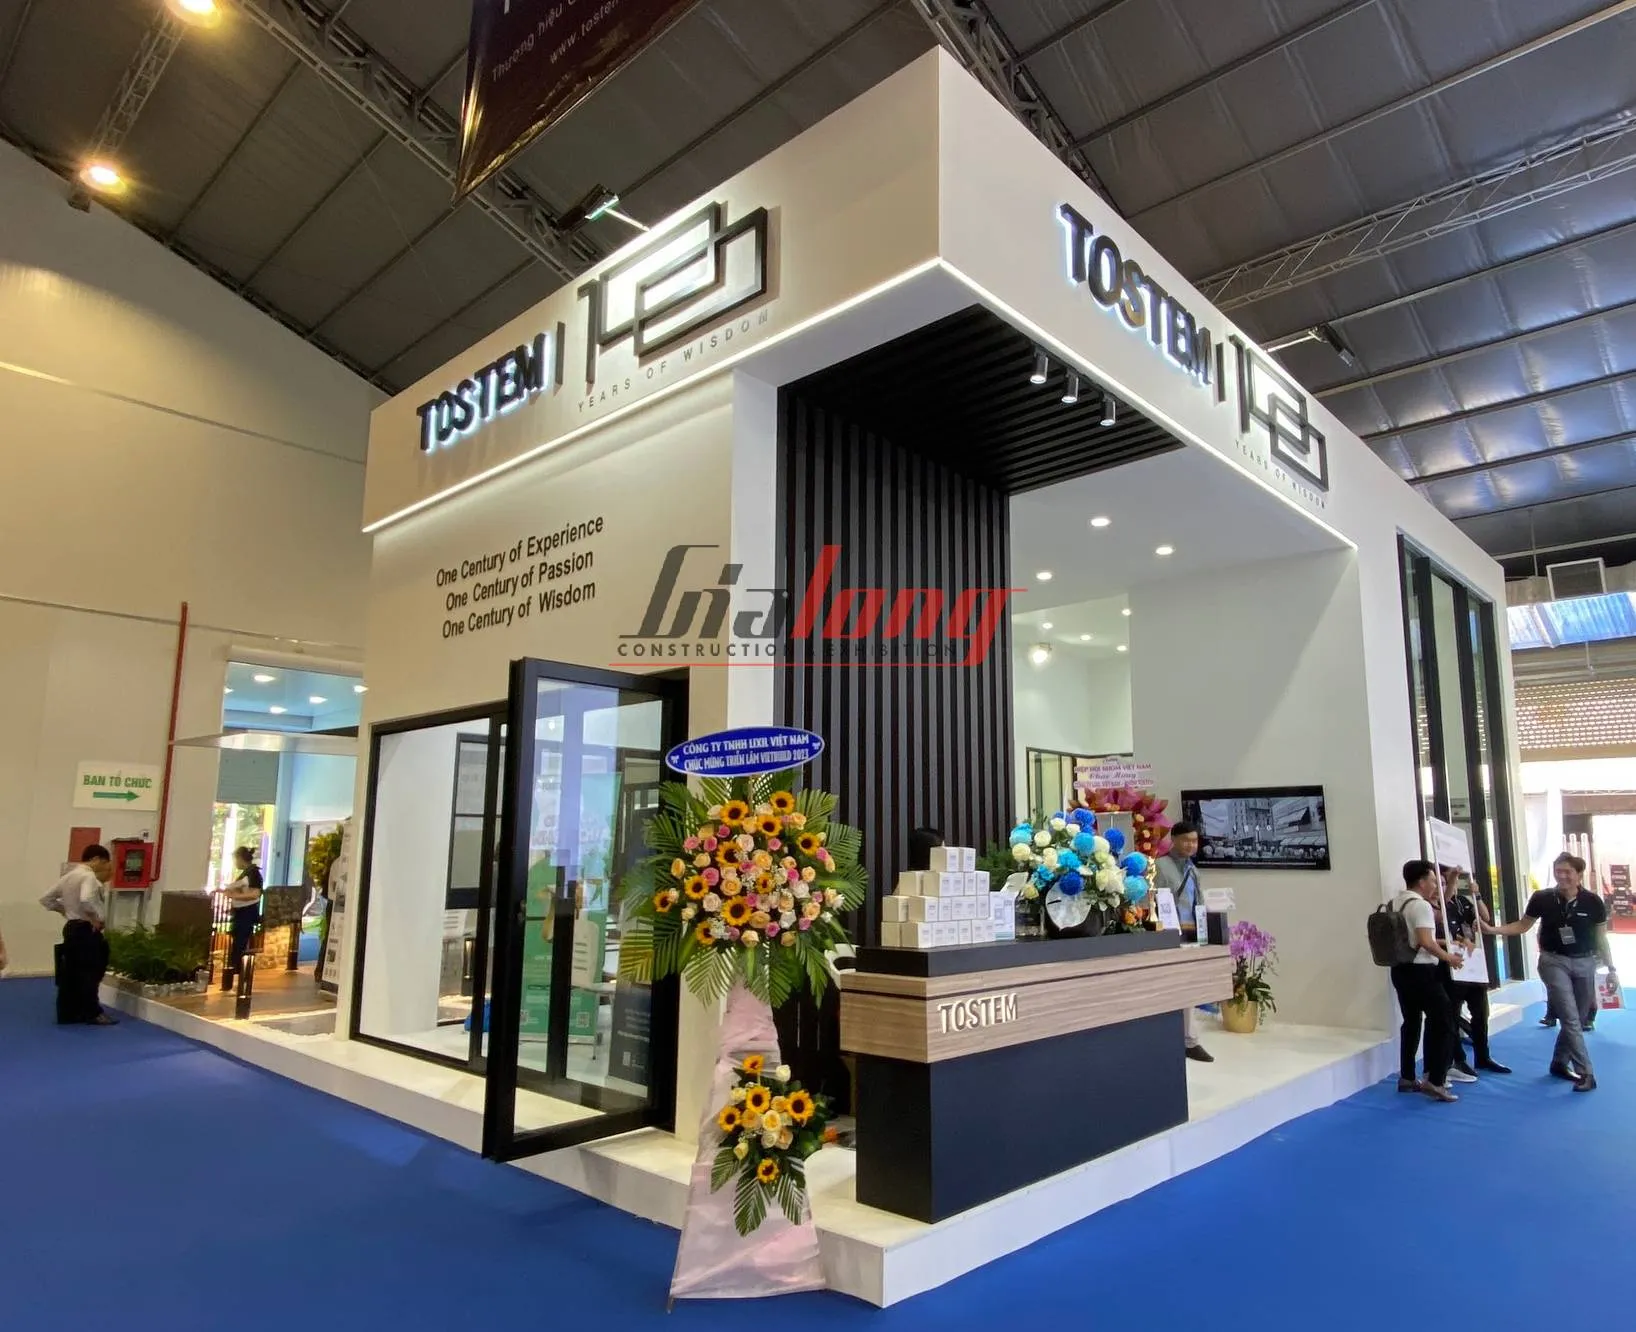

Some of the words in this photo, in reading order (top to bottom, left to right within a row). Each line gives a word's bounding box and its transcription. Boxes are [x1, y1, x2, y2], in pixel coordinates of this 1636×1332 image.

[1056, 203, 1212, 386] TOSTEM
[578, 378, 631, 412] YEARS
[646, 361, 668, 379] OF
[683, 309, 768, 361] WISDOM
[416, 332, 548, 452] TOSTEM
[436, 567, 457, 587] One
[461, 551, 505, 579] Century
[509, 540, 523, 562] of
[527, 516, 603, 556] Experience
[442, 620, 464, 638] One
[468, 605, 515, 632] Century
[518, 596, 532, 618] of
[538, 582, 596, 613] Wisdom
[446, 591, 468, 611] One
[473, 575, 519, 602] Century
[521, 565, 535, 588] of
[538, 551, 593, 584] Passion
[683, 741, 709, 755] CÔNG
[711, 741, 722, 752] TY
[724, 739, 747, 750] TNHH
[770, 733, 788, 747] VIỆT
[790, 734, 809, 745] NAM
[684, 757, 704, 771] CHÚC
[83, 775, 106, 786] BAN
[937, 993, 1018, 1034] TOSTEM
